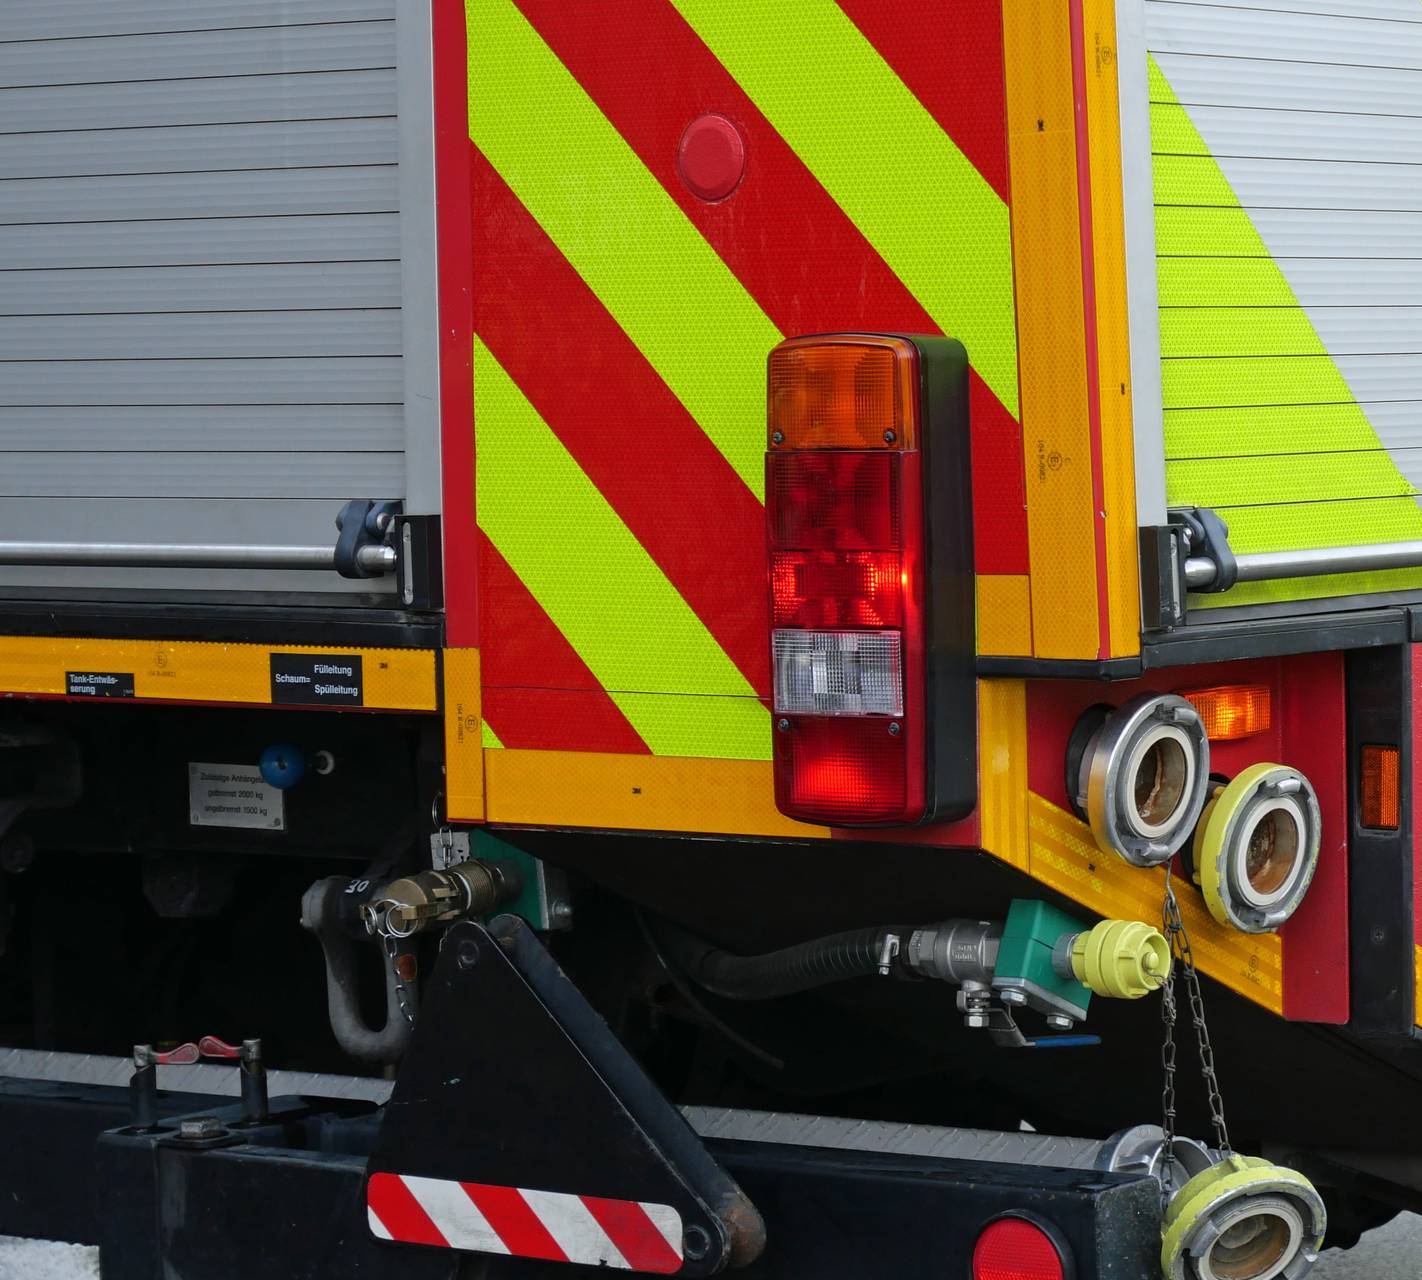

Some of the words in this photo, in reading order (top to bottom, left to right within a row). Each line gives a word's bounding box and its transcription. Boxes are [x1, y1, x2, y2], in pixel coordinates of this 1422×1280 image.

[314, 664, 353, 677] Fülleitung
[69, 674, 119, 684] Tank-Entwäs-
[275, 673, 311, 683] Schaum=
[70, 685, 96, 695] serung
[314, 684, 359, 697] Spülleitung
